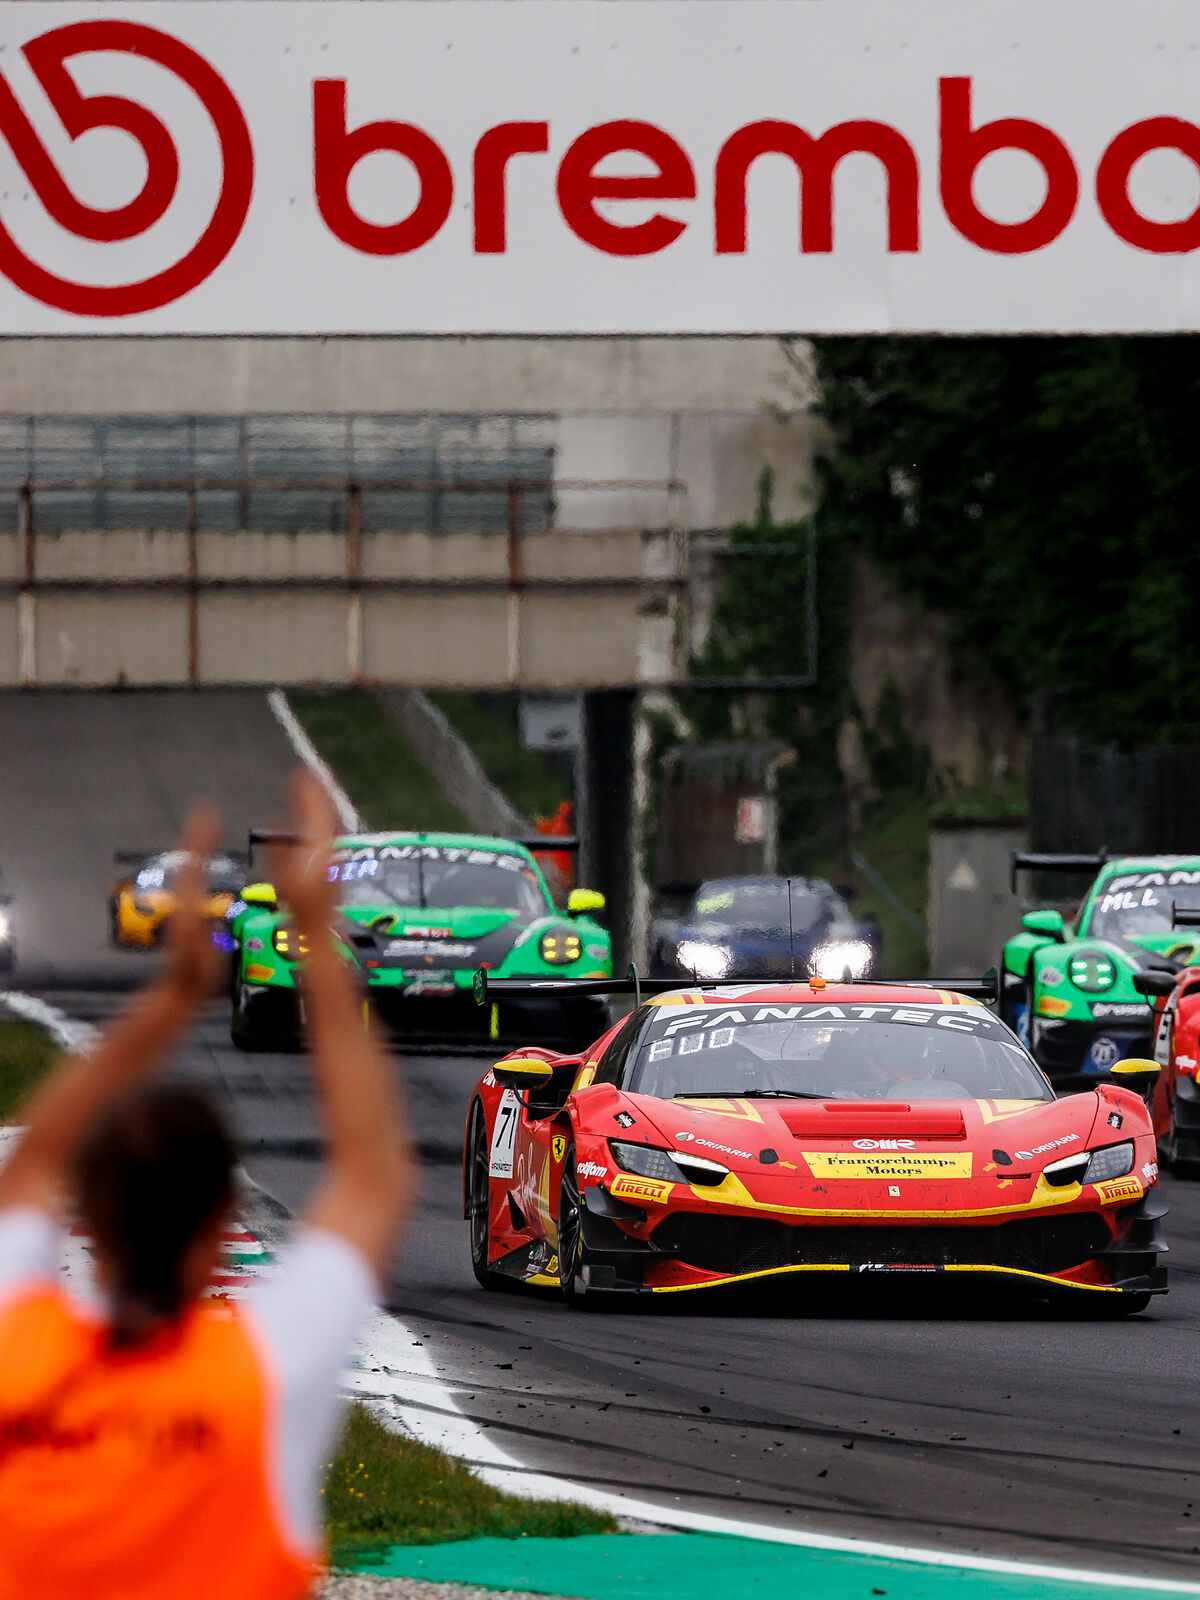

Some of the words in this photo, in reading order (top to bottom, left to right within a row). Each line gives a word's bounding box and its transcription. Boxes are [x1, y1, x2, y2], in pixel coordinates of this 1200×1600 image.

[663, 1006, 988, 1036] FANATEC
[495, 1107, 516, 1150] 71
[695, 1138, 752, 1158] ORIFARM
[1032, 1133, 1080, 1154] ORIFARM
[827, 1157, 956, 1167] Francorchamps
[866, 1166, 922, 1175] Motors
[615, 1179, 666, 1198] PIRELLI
[1100, 1181, 1140, 1199] PIRELLI
